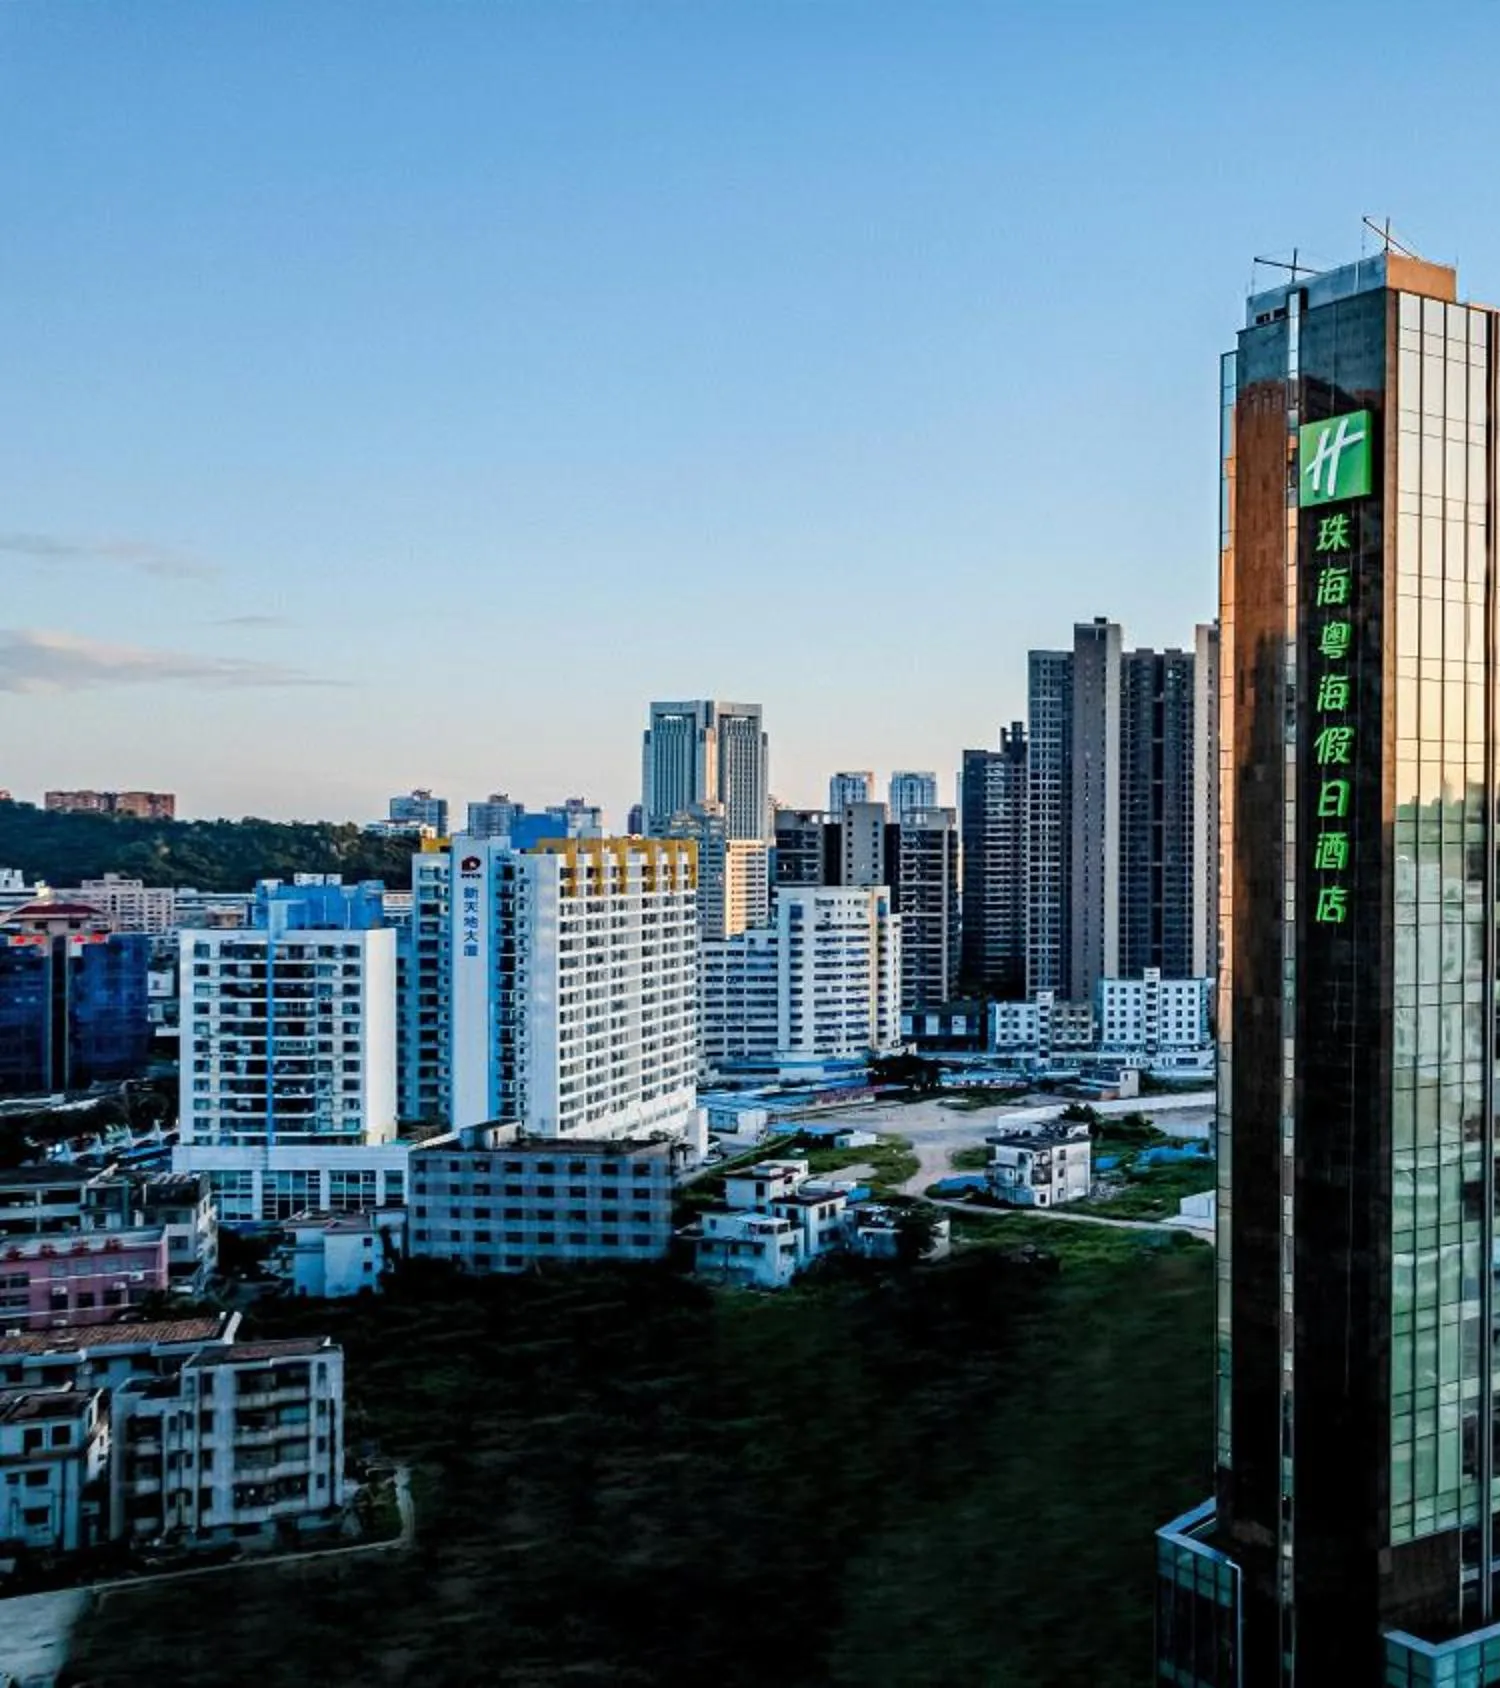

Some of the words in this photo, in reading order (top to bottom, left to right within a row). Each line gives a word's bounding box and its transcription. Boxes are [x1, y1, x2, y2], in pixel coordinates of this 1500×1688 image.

[1305, 418, 1365, 497] H
[1313, 513, 1354, 922] 珠海粤海假日酒店
